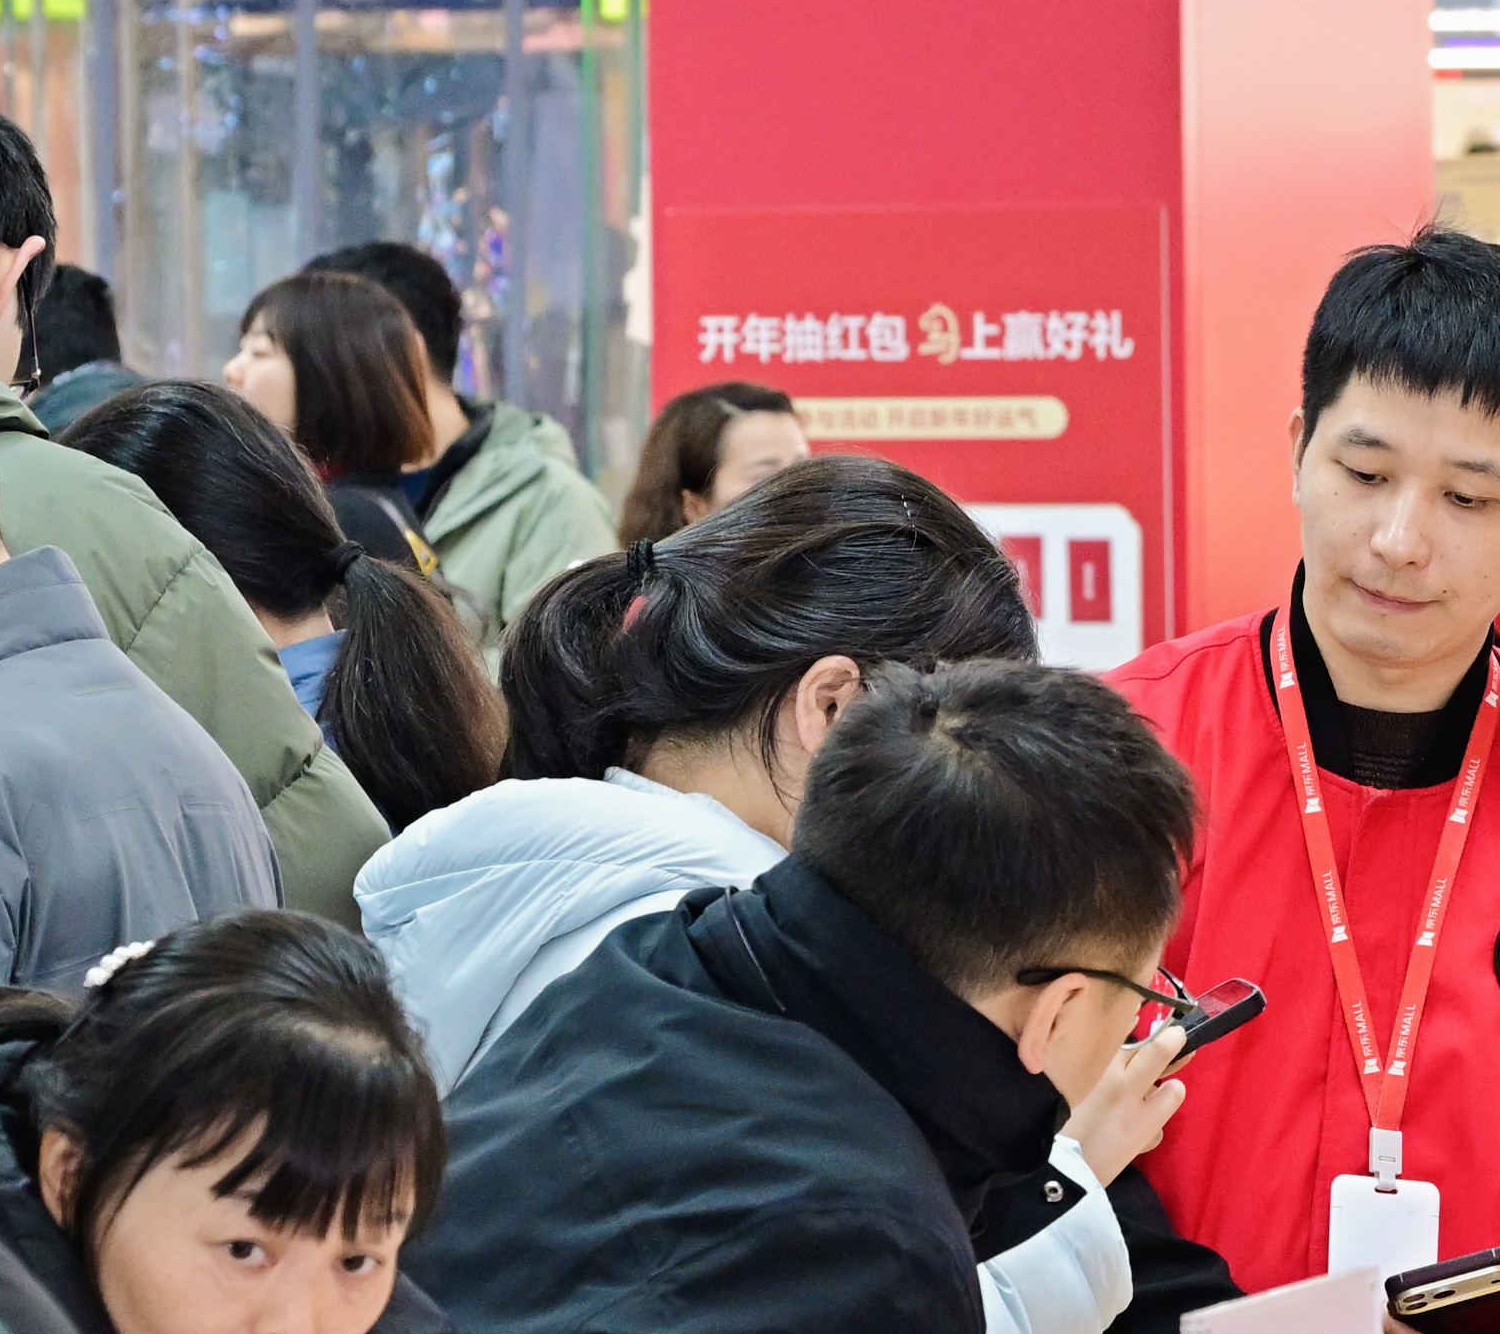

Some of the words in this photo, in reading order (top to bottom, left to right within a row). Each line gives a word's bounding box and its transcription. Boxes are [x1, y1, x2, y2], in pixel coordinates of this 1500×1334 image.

[699, 312, 909, 364] 开年抽红包
[918, 303, 1134, 364] 马上赢好礼
[1296, 741, 1317, 796] 京东MALL
[1458, 758, 1481, 808] 京东MALL
[1322, 869, 1342, 925] 京东MALL
[1425, 877, 1447, 930] 京东MALL
[1352, 1000, 1374, 1057] 京东MALL
[1395, 1004, 1417, 1059] 京东MALL
